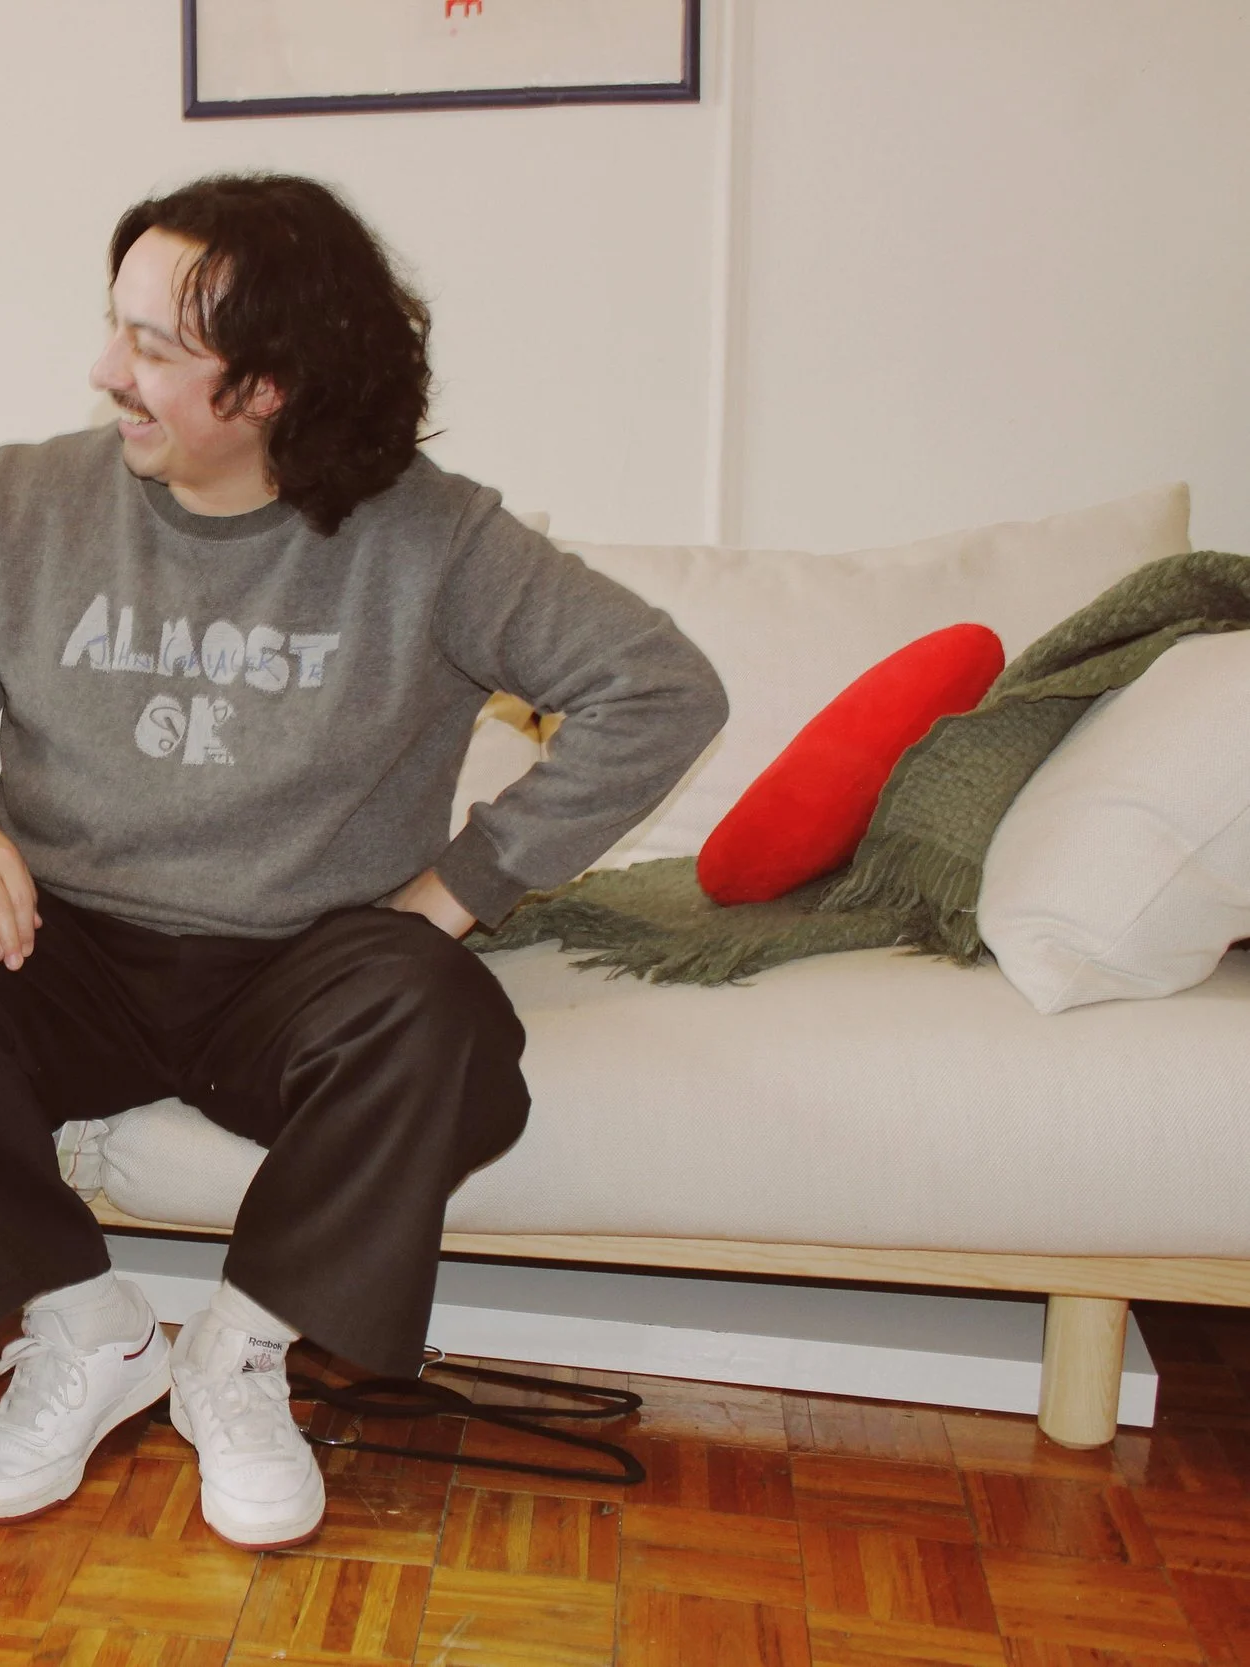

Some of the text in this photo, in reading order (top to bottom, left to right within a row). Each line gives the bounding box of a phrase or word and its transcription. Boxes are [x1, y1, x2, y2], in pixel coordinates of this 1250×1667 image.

[59, 592, 341, 694] ALMOST
[133, 694, 236, 767] OK
[248, 1336, 283, 1350] Reebok
